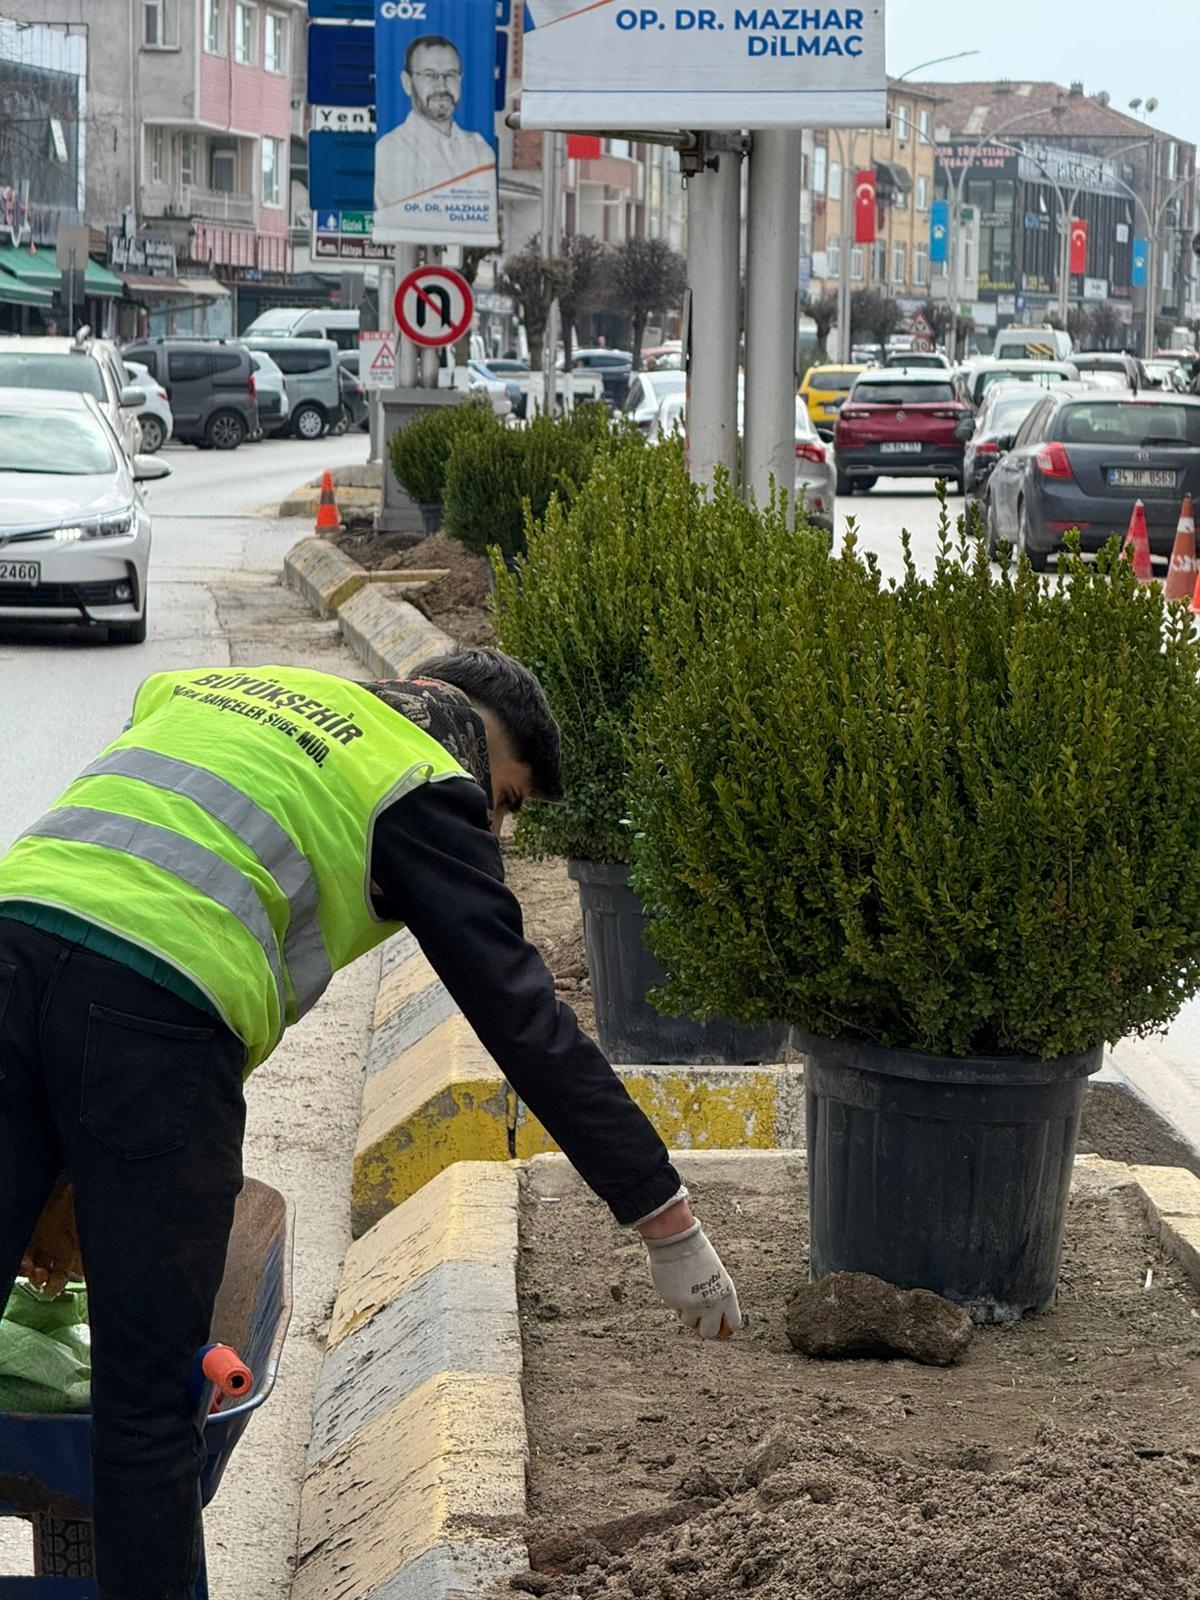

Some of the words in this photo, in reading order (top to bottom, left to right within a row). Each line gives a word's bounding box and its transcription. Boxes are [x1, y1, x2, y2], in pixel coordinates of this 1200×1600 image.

[380, 0, 427, 19] GÖZ
[616, 9, 665, 31] OP.
[675, 9, 725, 31] DR.
[734, 9, 864, 31] MAZHAR
[747, 35, 864, 58] DİLMAÇ
[404, 203, 422, 213] OP.
[424, 203, 443, 213] DR.
[445, 203, 490, 213] MAZHAR
[364, 331, 395, 341] DİKKA
[1117, 469, 1128, 483] 34
[0, 564, 37, 579] 2460
[190, 672, 364, 746] BÜYÜKŞEHİR
[199, 693, 267, 720] BAHÇELER
[260, 712, 299, 737] ŞUBE
[295, 730, 331, 769] MÜD.
